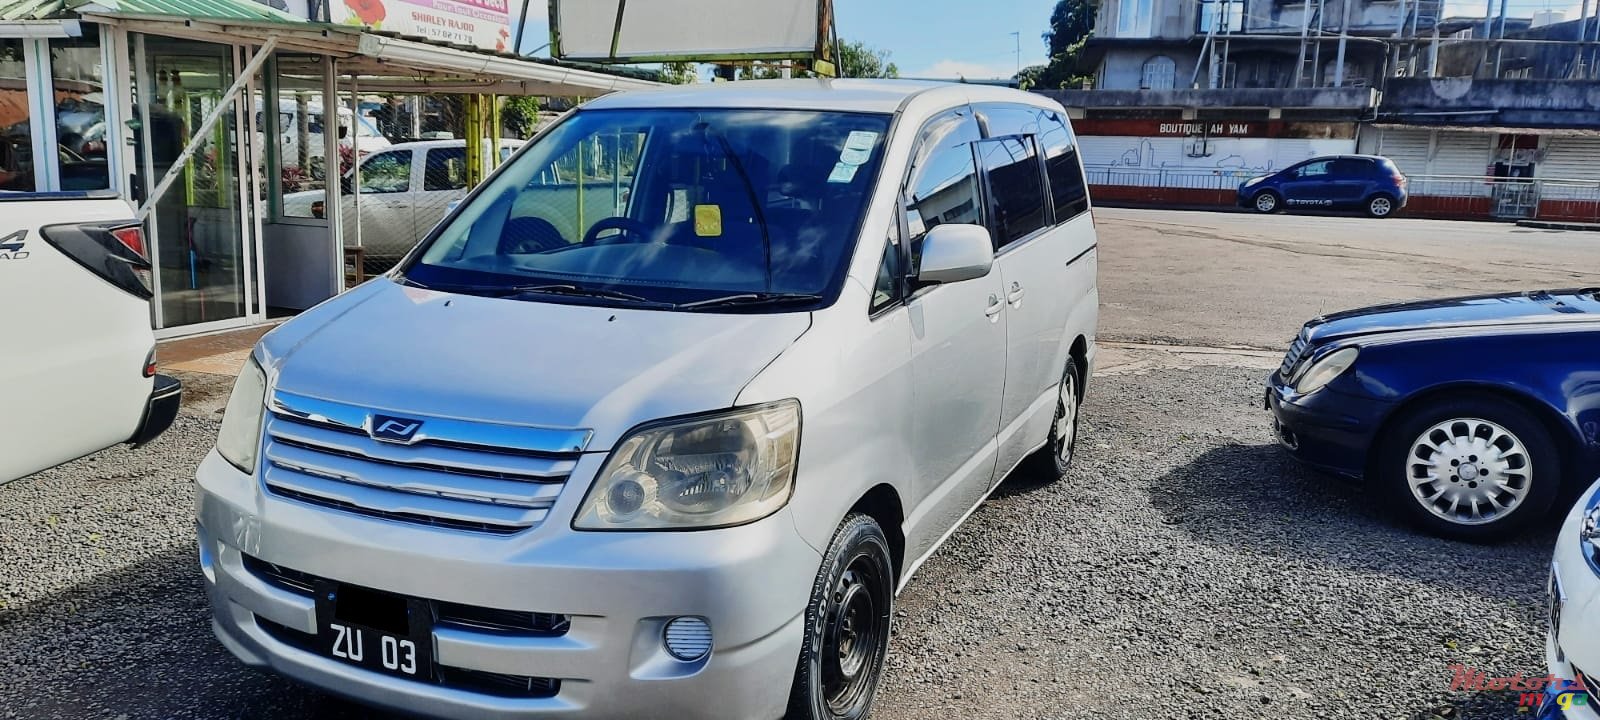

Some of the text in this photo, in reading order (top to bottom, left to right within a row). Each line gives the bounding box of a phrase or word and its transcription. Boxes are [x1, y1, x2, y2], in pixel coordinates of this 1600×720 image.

[411, 11, 447, 26] SHIRLEY
[1160, 123, 1248, 134] BOUTIQUE AH YAM
[330, 623, 417, 675] ZU 03
